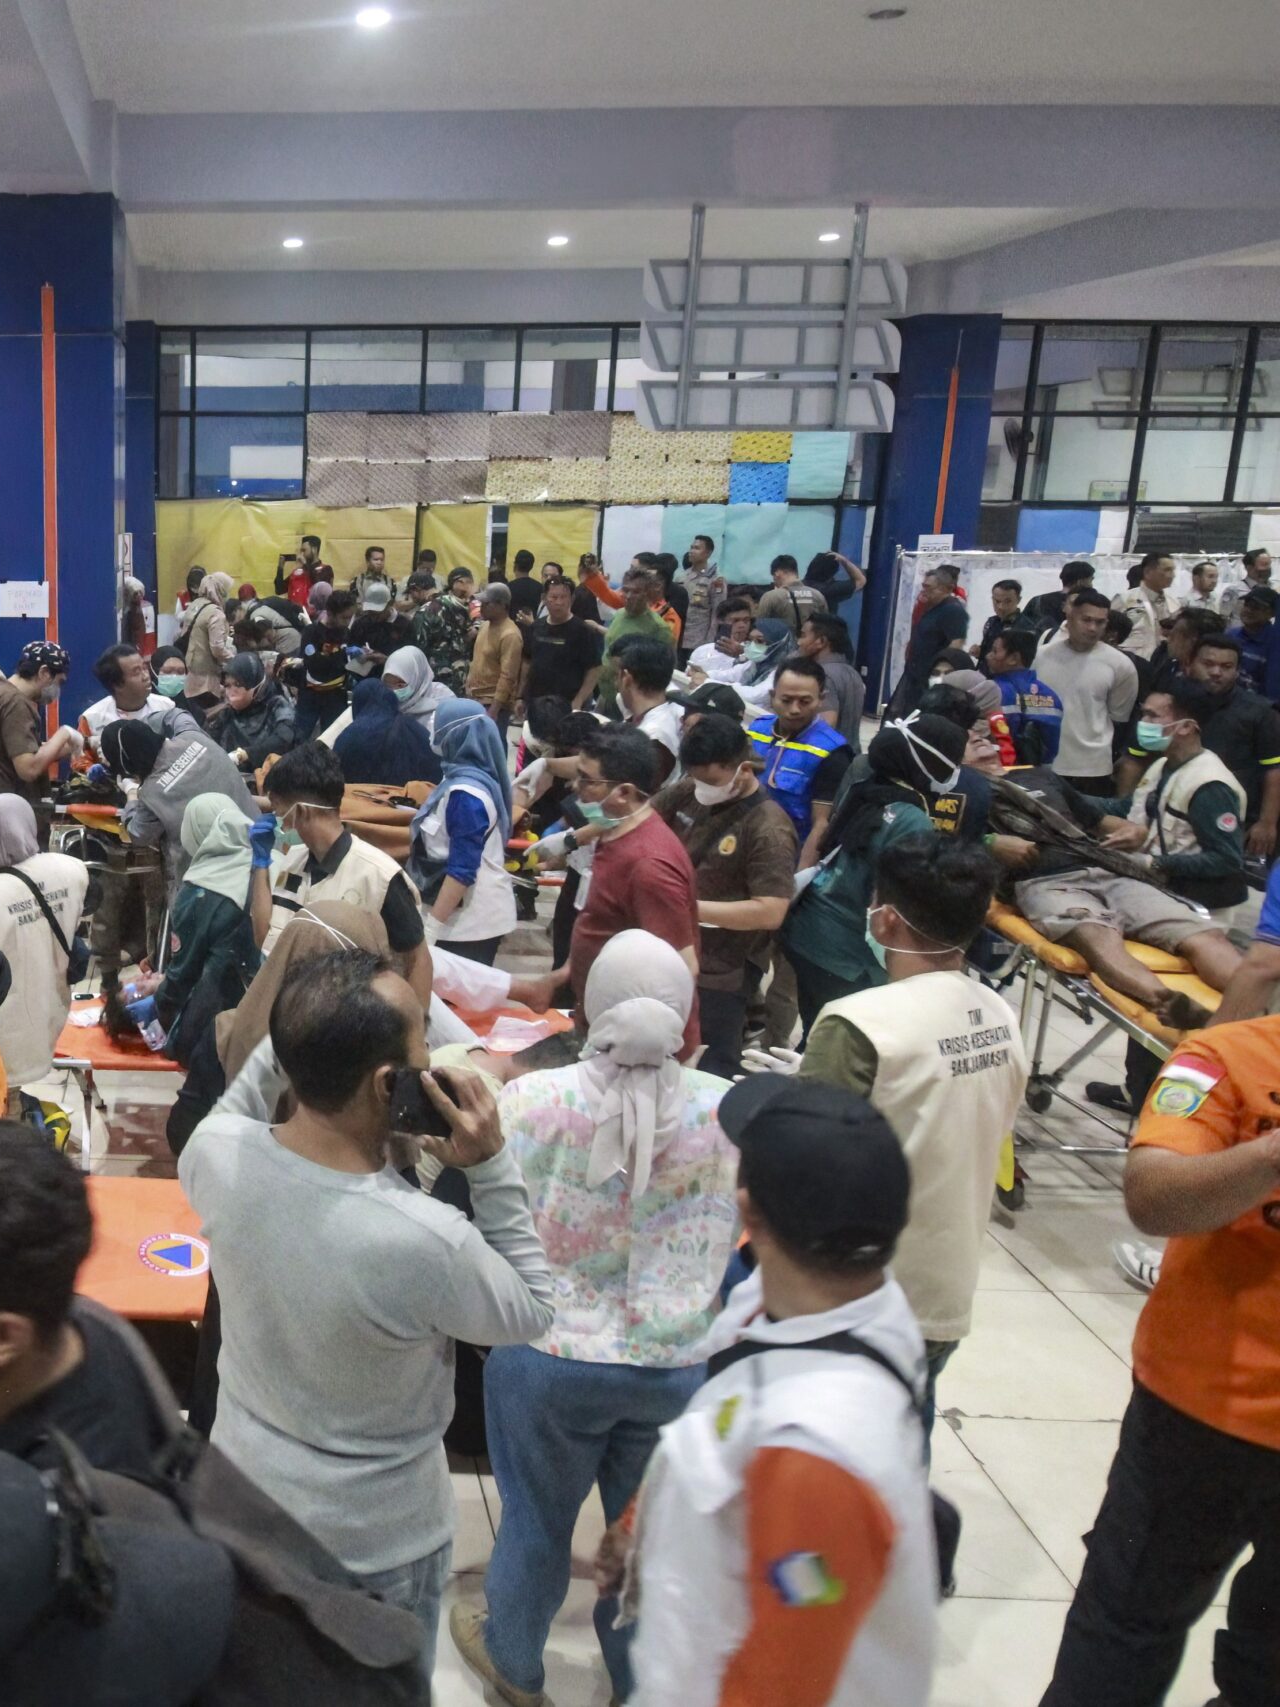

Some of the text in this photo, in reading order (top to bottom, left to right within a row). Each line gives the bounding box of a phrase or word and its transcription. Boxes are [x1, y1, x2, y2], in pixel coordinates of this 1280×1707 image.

[156, 741, 203, 787] TIM KESEHATAN
[8, 899, 33, 914] KRISIS
[967, 1008, 983, 1026] TIM
[937, 1024, 1012, 1056] KRISIS KESEHATAN
[951, 1048, 1009, 1077] BANJARMASIN
